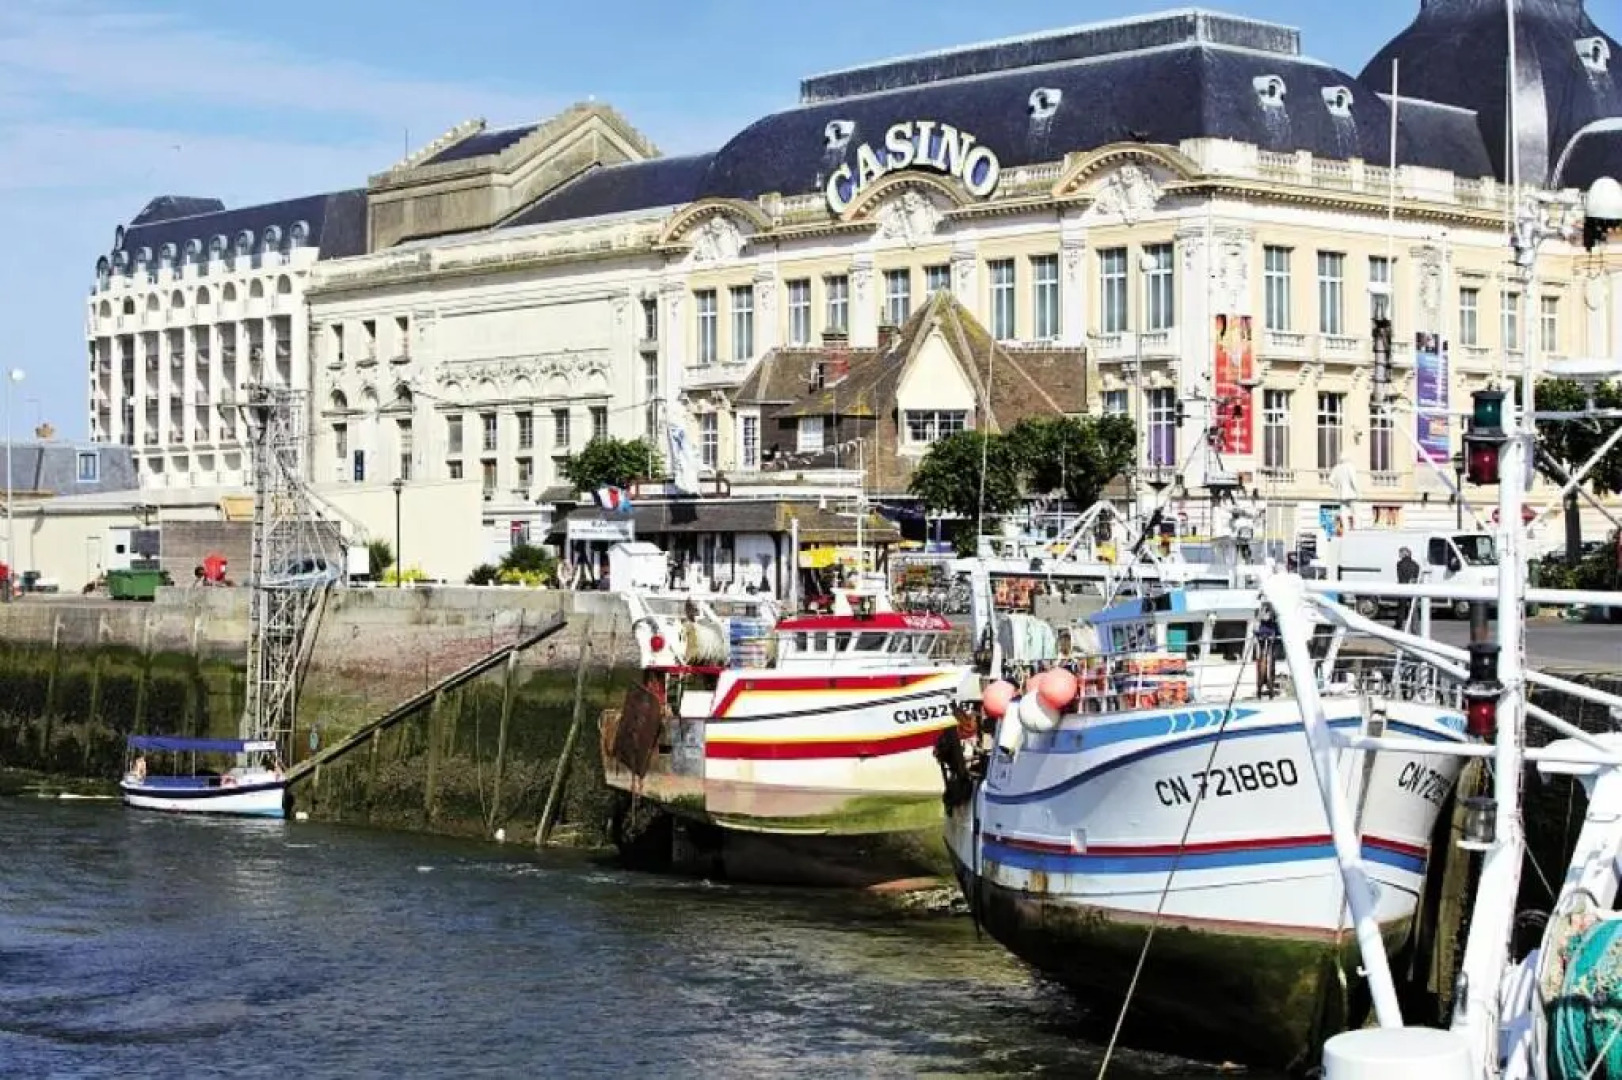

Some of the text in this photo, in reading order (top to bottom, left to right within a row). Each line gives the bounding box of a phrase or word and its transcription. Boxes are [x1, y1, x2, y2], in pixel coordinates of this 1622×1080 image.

[826, 121, 1000, 214] CASINO
[1155, 758, 1298, 806] CN 721860
